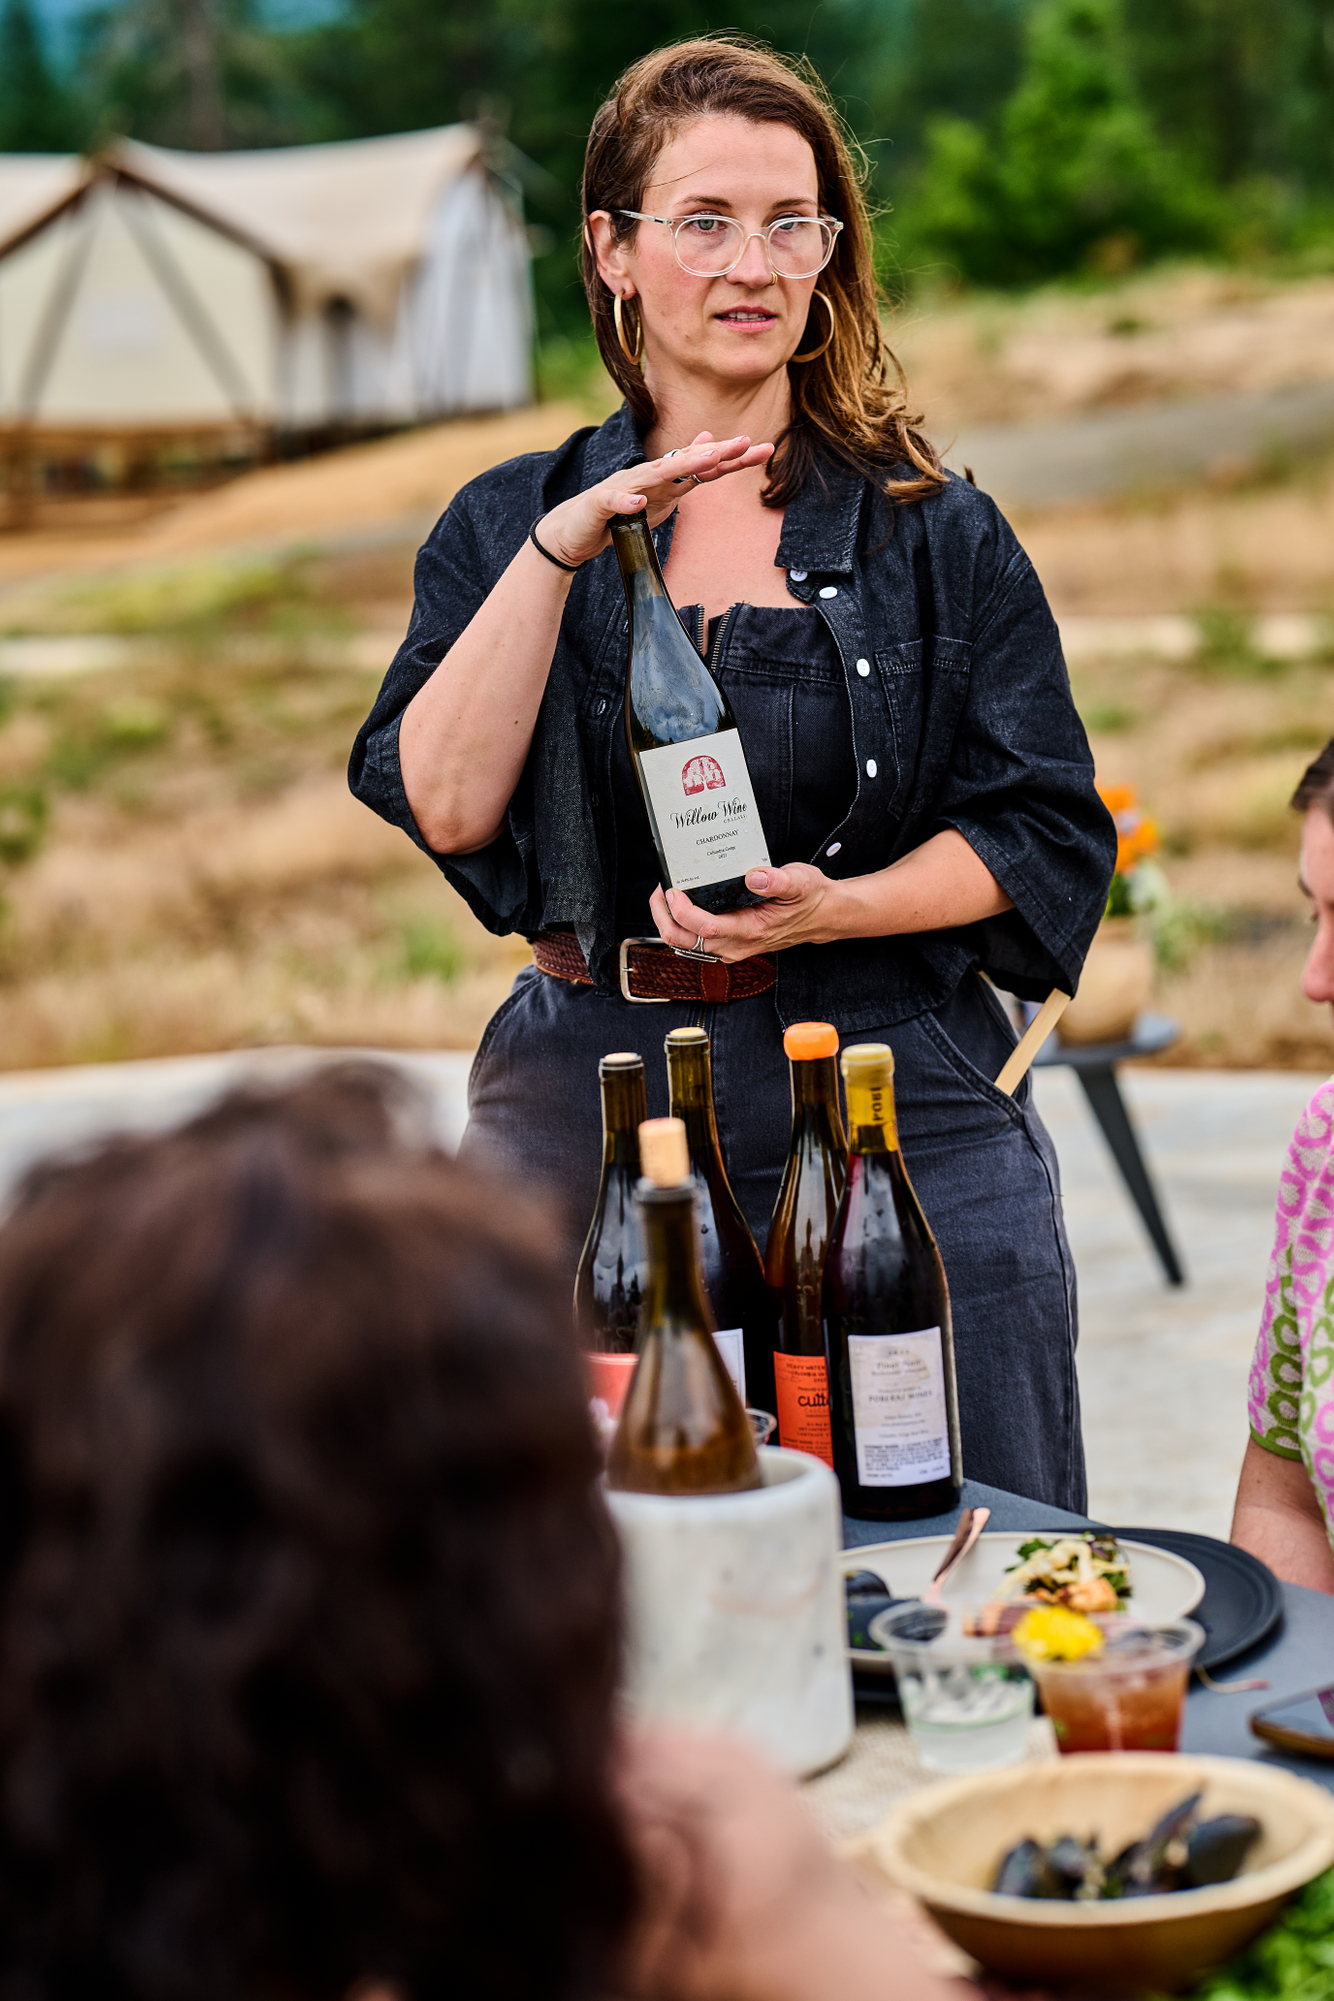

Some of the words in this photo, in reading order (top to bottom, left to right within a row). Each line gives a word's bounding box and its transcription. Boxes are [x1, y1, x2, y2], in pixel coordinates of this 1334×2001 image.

[669, 806, 719, 829] Willow
[717, 796, 748, 817] Wine
[695, 829, 739, 846] CHARDONNAY
